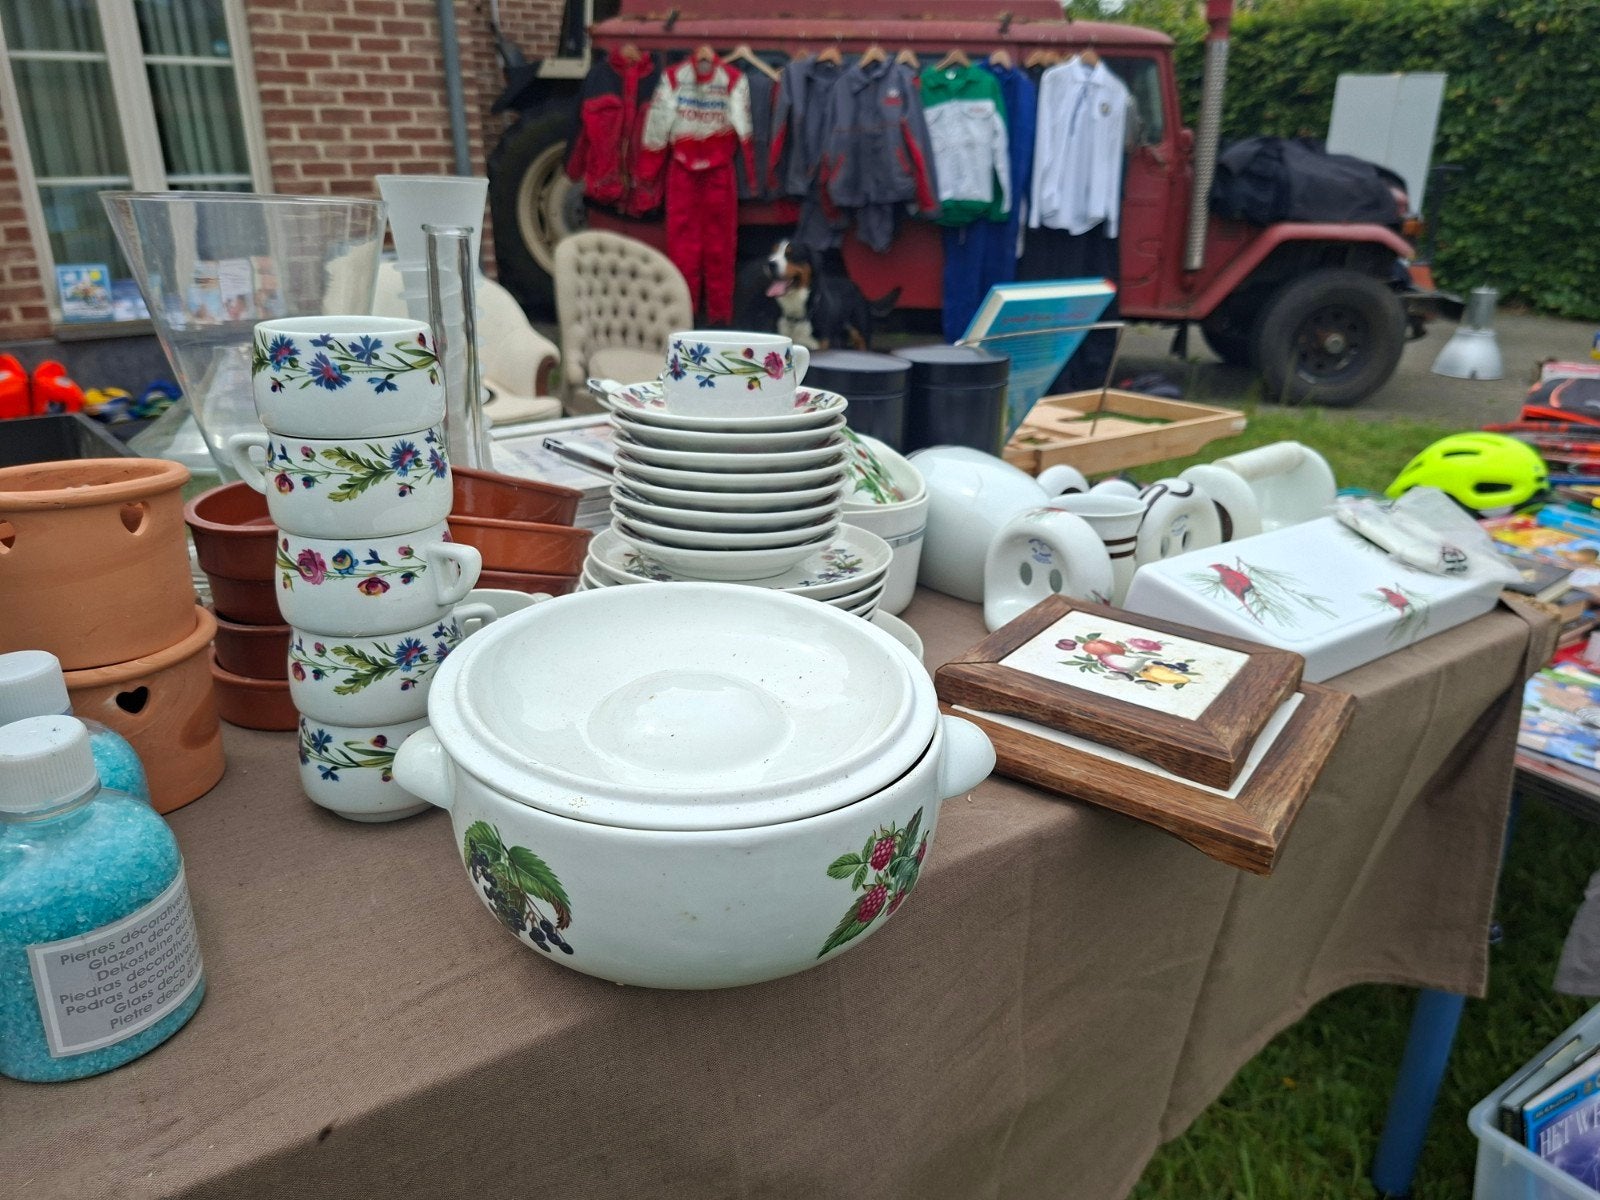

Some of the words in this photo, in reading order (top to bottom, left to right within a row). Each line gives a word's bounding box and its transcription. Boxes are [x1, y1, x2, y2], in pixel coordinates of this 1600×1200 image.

[59, 979, 122, 1005] Piedras
[126, 929, 190, 982] decorativas
[60, 941, 115, 966] Pierres
[88, 942, 144, 971] Glazen
[96, 934, 172, 982] Dekosteine
[66, 992, 123, 1016] Pedras
[128, 943, 192, 994] decorativas
[110, 1003, 153, 1029] Pietre
[157, 978, 186, 1004] deco
[113, 989, 154, 1014] Glass
[157, 963, 186, 991] deco
[1539, 1115, 1571, 1159] HET
